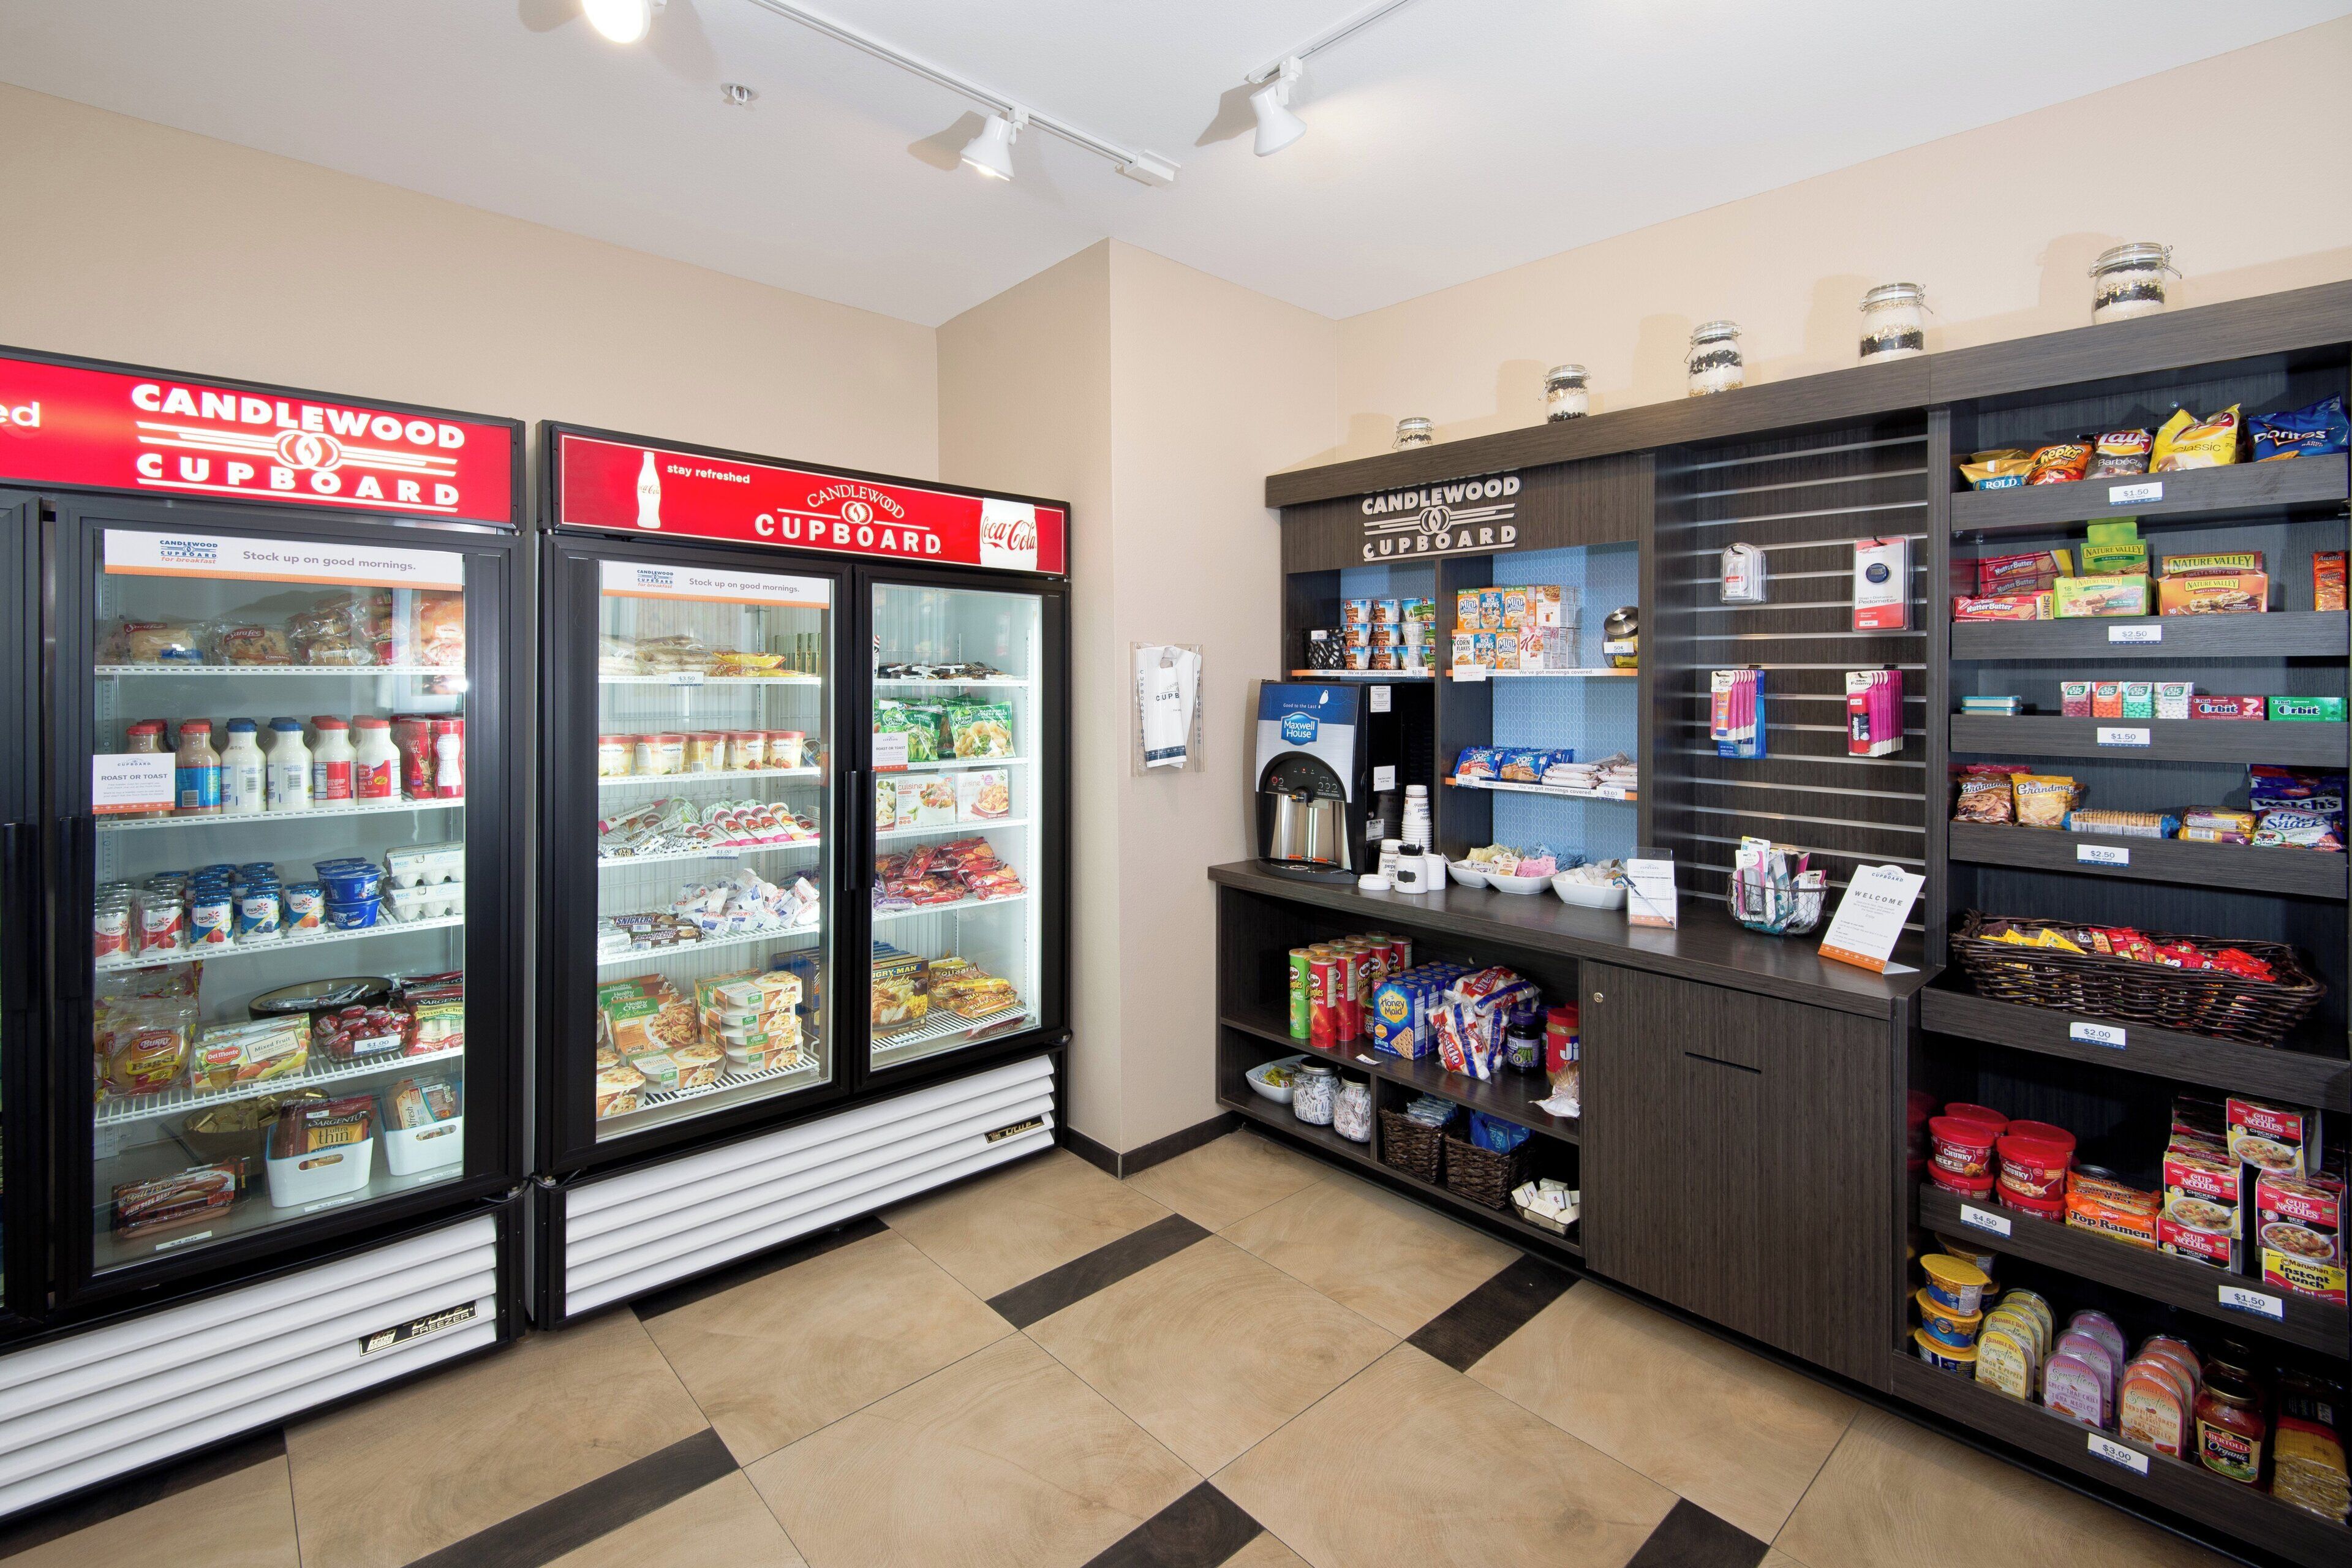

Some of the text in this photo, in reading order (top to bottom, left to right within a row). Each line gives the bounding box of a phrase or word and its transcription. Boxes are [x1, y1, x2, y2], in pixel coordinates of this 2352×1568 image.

[131, 384, 465, 449] CANDLEWOOD
[2254, 429, 2326, 444] Doritos
[2173, 442, 2221, 453] Classic
[137, 453, 459, 506] CUPBOARD
[668, 464, 750, 483] stay refreshed
[1986, 478, 2018, 489] ROLD
[807, 484, 905, 519] CANDLEWOOD
[1362, 476, 1520, 515] CANDLEWOOD
[755, 513, 940, 554] CUPBOARD
[982, 516, 1037, 551] Coca-Cola
[1363, 526, 1517, 559] CUPBOARD
[243, 551, 279, 561] Stock
[284, 554, 299, 564] up
[323, 557, 355, 567] good
[359, 560, 416, 571] mornings.
[2173, 555, 2251, 571] NATURE VALLEY
[689, 578, 712, 586] Stock
[740, 581, 760, 590] good
[763, 584, 799, 594] mornings.
[2187, 581, 2211, 589] NATURE
[1459, 599, 1477, 608] Mini
[2199, 704, 2238, 714] Orbit
[2278, 705, 2320, 715] Orbit
[1284, 720, 1315, 731] Maxwell
[1286, 729, 1311, 739] House
[2255, 798, 2338, 810] Welch's
[1855, 890, 1903, 907] WELCOME
[616, 915, 655, 925] SNICKERS
[872, 965, 918, 979] NGRY-MAN
[1381, 998, 1405, 1010] Honey
[1385, 1007, 1403, 1016] Maid
[616, 1008, 658, 1020] Café Steamers
[2084, 1028, 2111, 1039] $2.00
[139, 1037, 171, 1049] BURRY
[255, 1036, 291, 1053] Mixed Fruit
[366, 1039, 389, 1048] $1.00
[219, 1049, 239, 1059] Monte
[1559, 1042, 1580, 1061] Ji
[131, 1055, 175, 1071] Bagel
[309, 1112, 363, 1128] SARGENTO
[2244, 1115, 2284, 1133] NOODLES
[2252, 1112, 2275, 1125] CUP
[318, 1128, 349, 1145] thin
[2249, 1128, 2280, 1139] CHICKEN
[1943, 1148, 1972, 1162] CHUNKY
[2181, 1176, 2222, 1194] NOODLES
[2190, 1174, 2213, 1186] CUP
[2187, 1189, 2217, 1200] CHICKEN
[1973, 1213, 1997, 1226] $4.50
[2100, 1210, 2119, 1219] NISSIN
[2070, 1210, 2151, 1239] Top Ramen
[2173, 1234, 2214, 1254] NOODLES
[2279, 1264, 2330, 1284] Instant
[2290, 1259, 2329, 1275] Maruchan
[2285, 1273, 2325, 1289] Lunch
[2234, 1293, 2265, 1306] $1.50
[412, 1312, 470, 1336] FREEZER
[1986, 1335, 2018, 1354] BUMBLE BEE
[1981, 1343, 2022, 1370] Sensations
[1982, 1366, 2019, 1389] TUNA MEDLEY
[2048, 1381, 2098, 1404] SPICY THAI CHILI
[2208, 1433, 2248, 1452] BERTOLLI
[2103, 1444, 2132, 1461] $3.00
[2208, 1441, 2248, 1461] Organic
